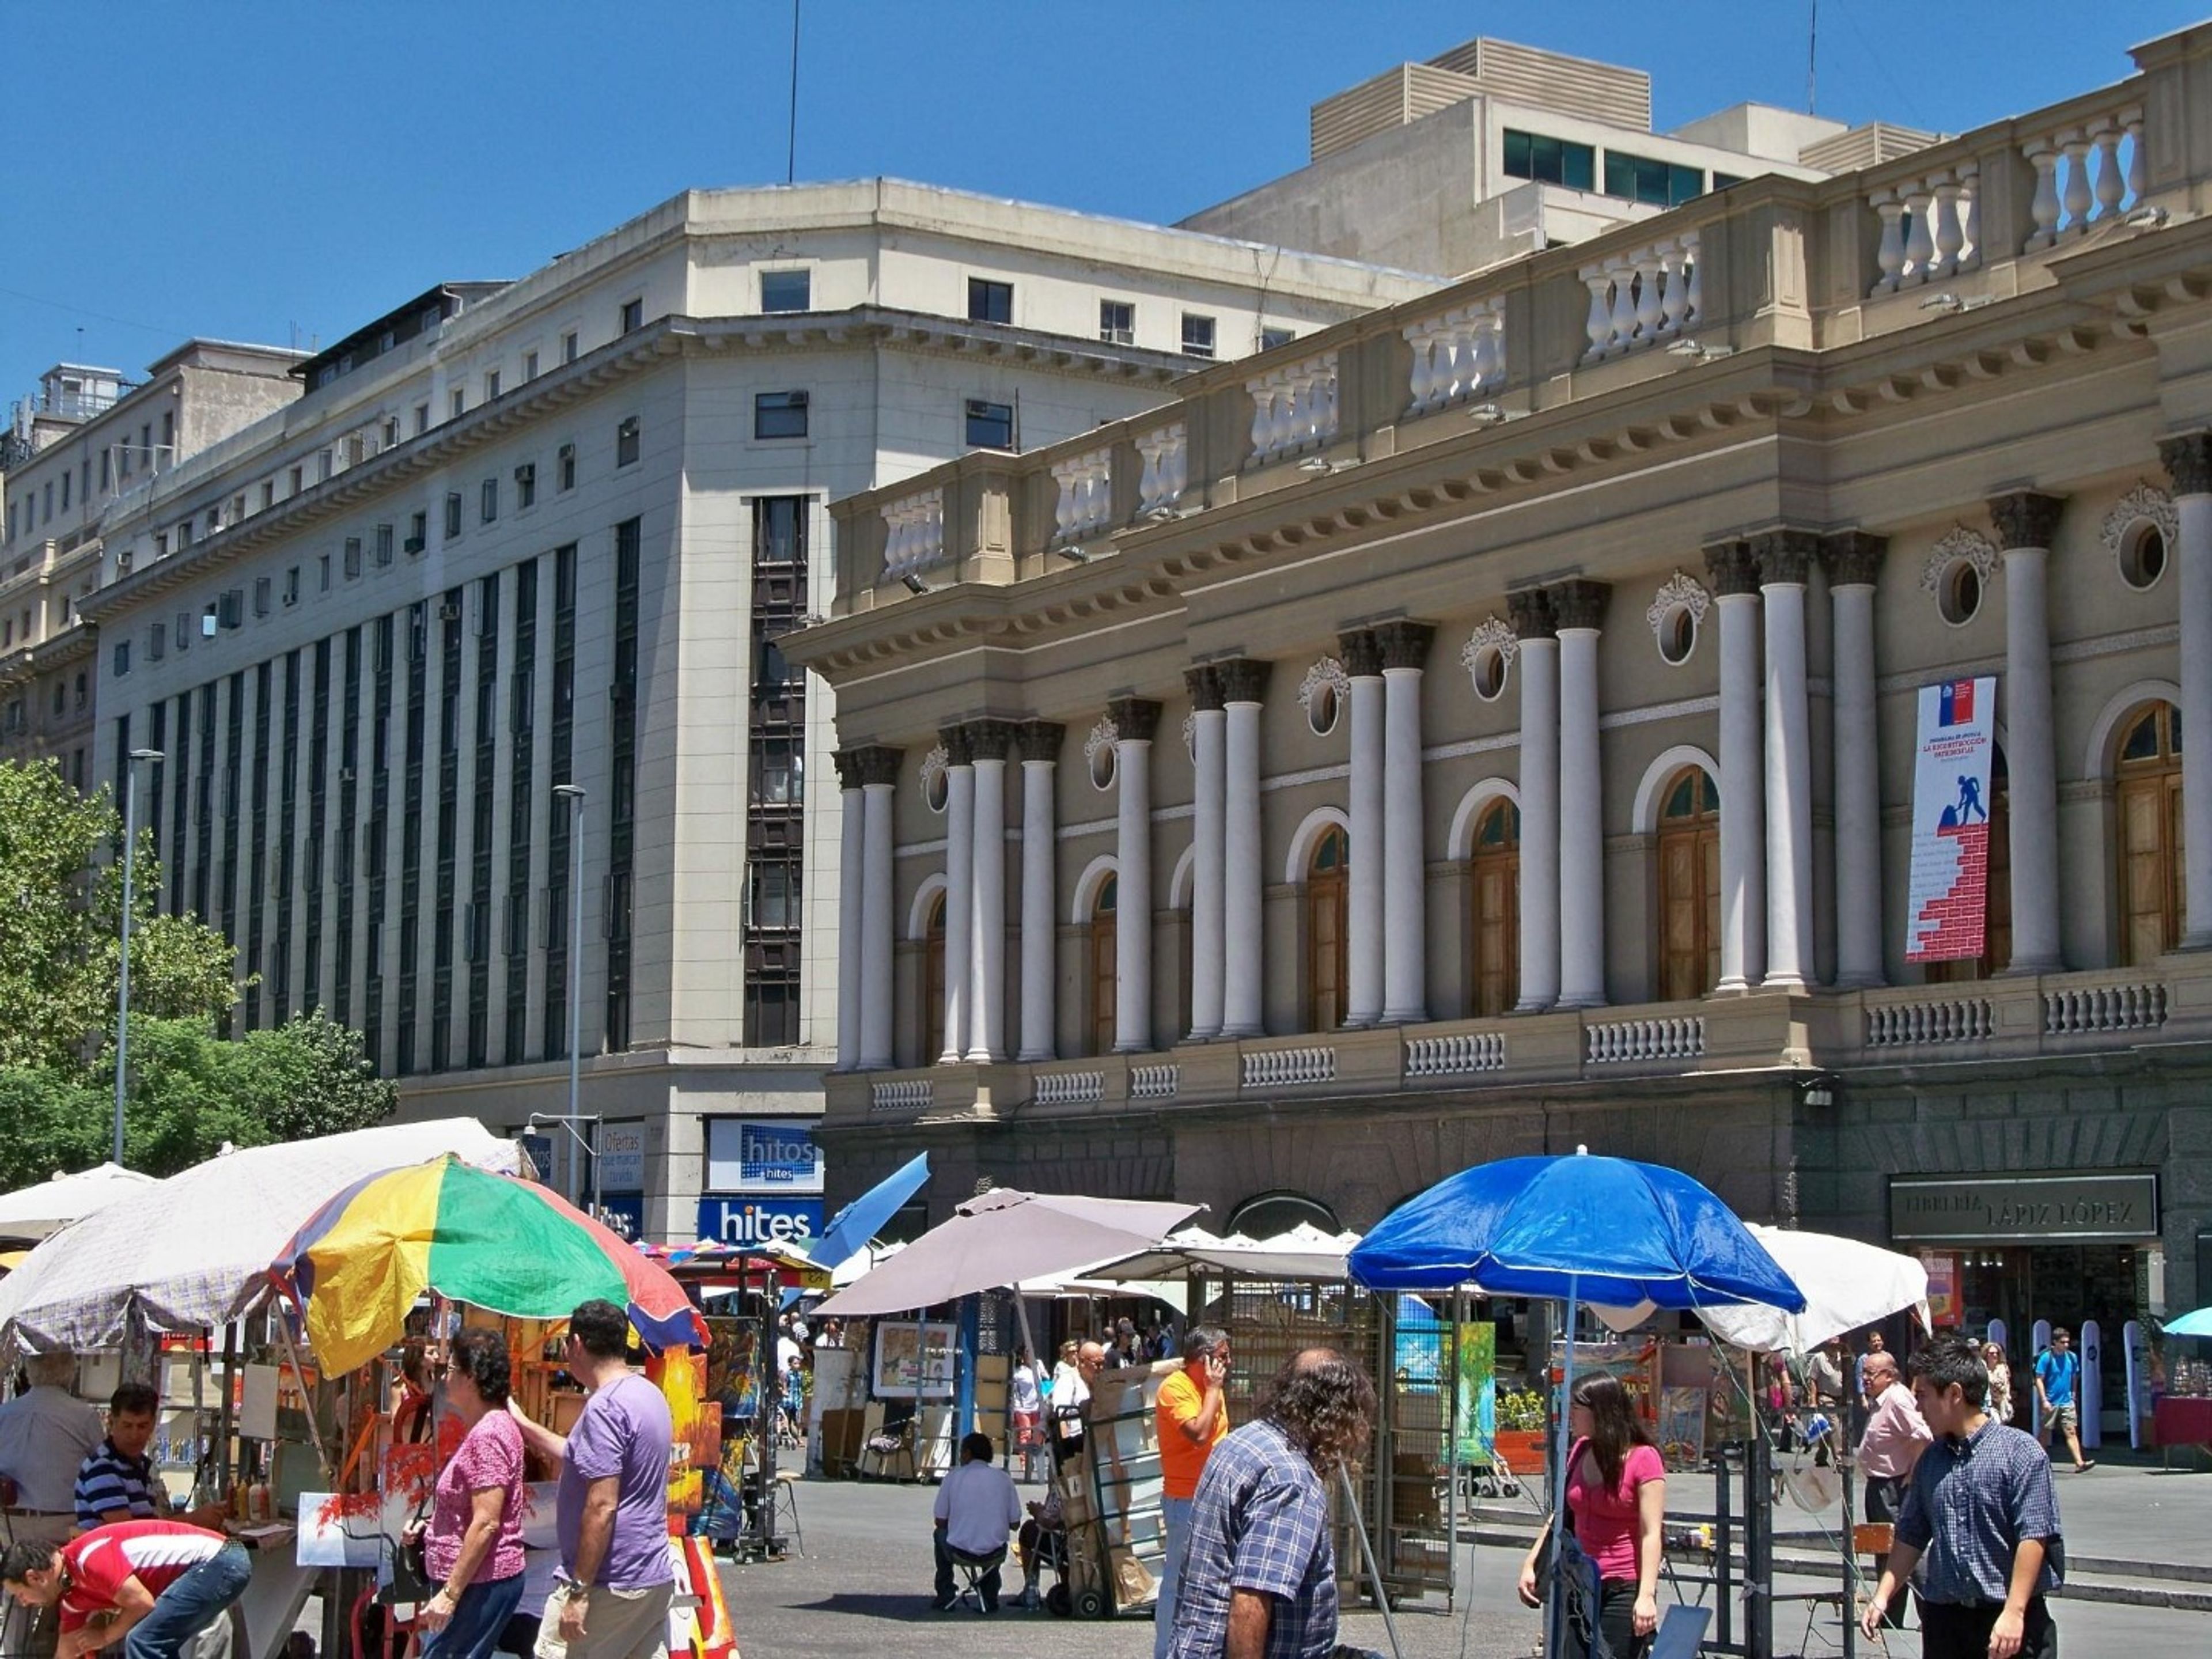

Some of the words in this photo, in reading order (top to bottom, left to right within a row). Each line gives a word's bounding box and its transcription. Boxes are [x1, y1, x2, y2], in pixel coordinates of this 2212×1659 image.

[605, 1132, 639, 1152] Ofertas
[749, 1135, 814, 1162] hitos
[767, 1168, 793, 1180] hites
[721, 1202, 811, 1241] hites
[1987, 1198, 2051, 1226] LÁPIZ
[2059, 1196, 2134, 1225] LÓPEZ
